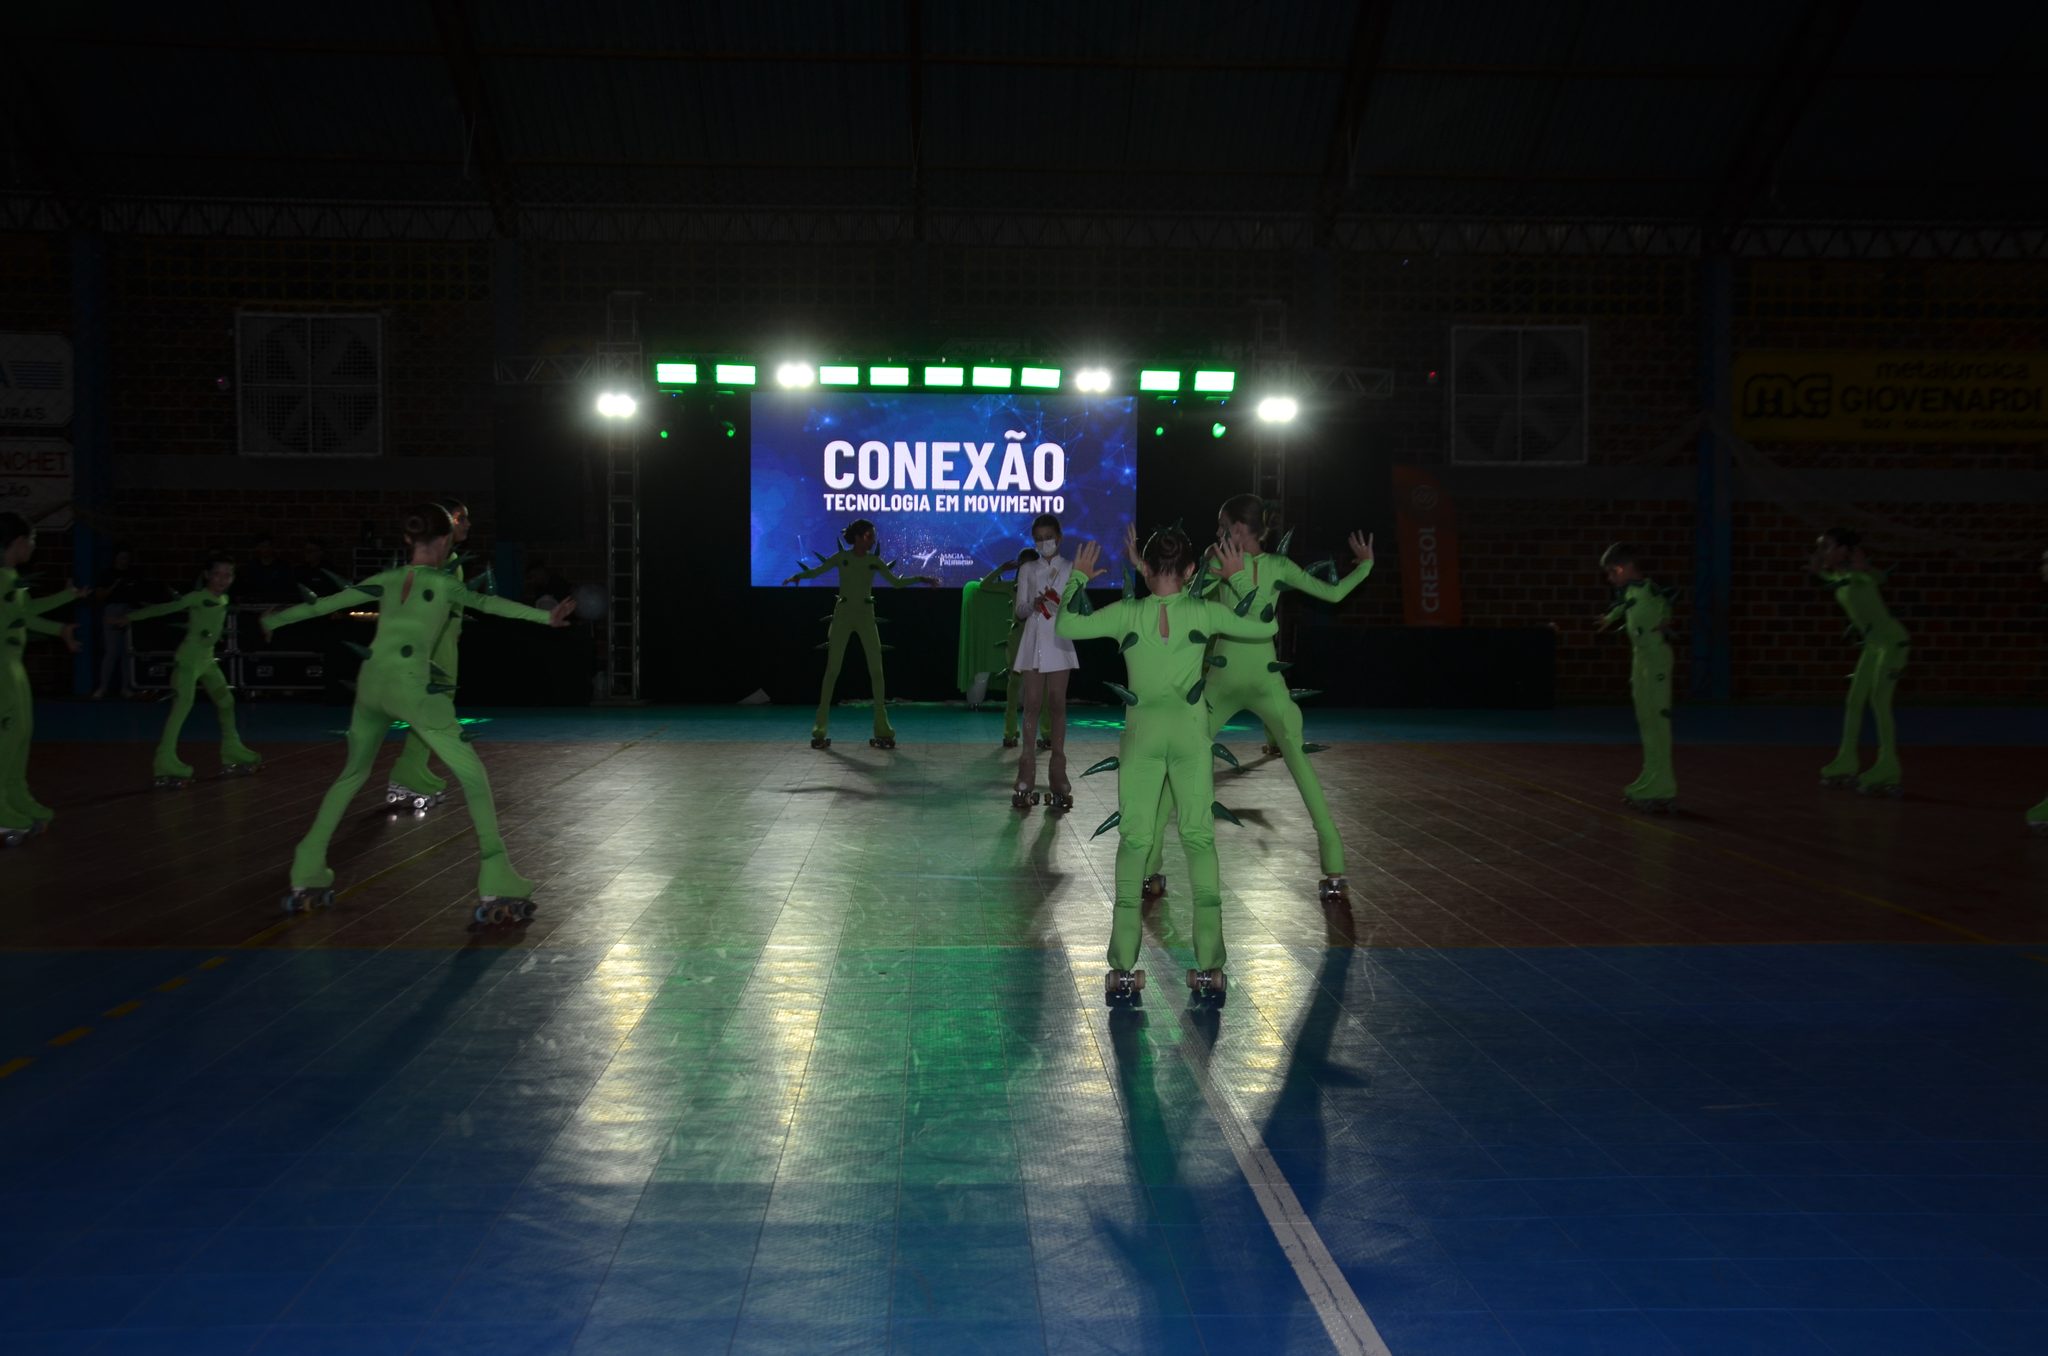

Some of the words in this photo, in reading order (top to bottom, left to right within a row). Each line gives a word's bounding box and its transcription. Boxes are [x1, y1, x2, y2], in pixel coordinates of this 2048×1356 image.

[1840, 386, 2041, 412] GIOVENARDI
[823, 429, 1065, 492] CONEXÃO
[823, 493, 931, 512] TECNOLOGIA
[935, 494, 959, 513] EM
[964, 495, 1065, 513] MOVIMENTO
[1419, 525, 1441, 614] CRESOL
